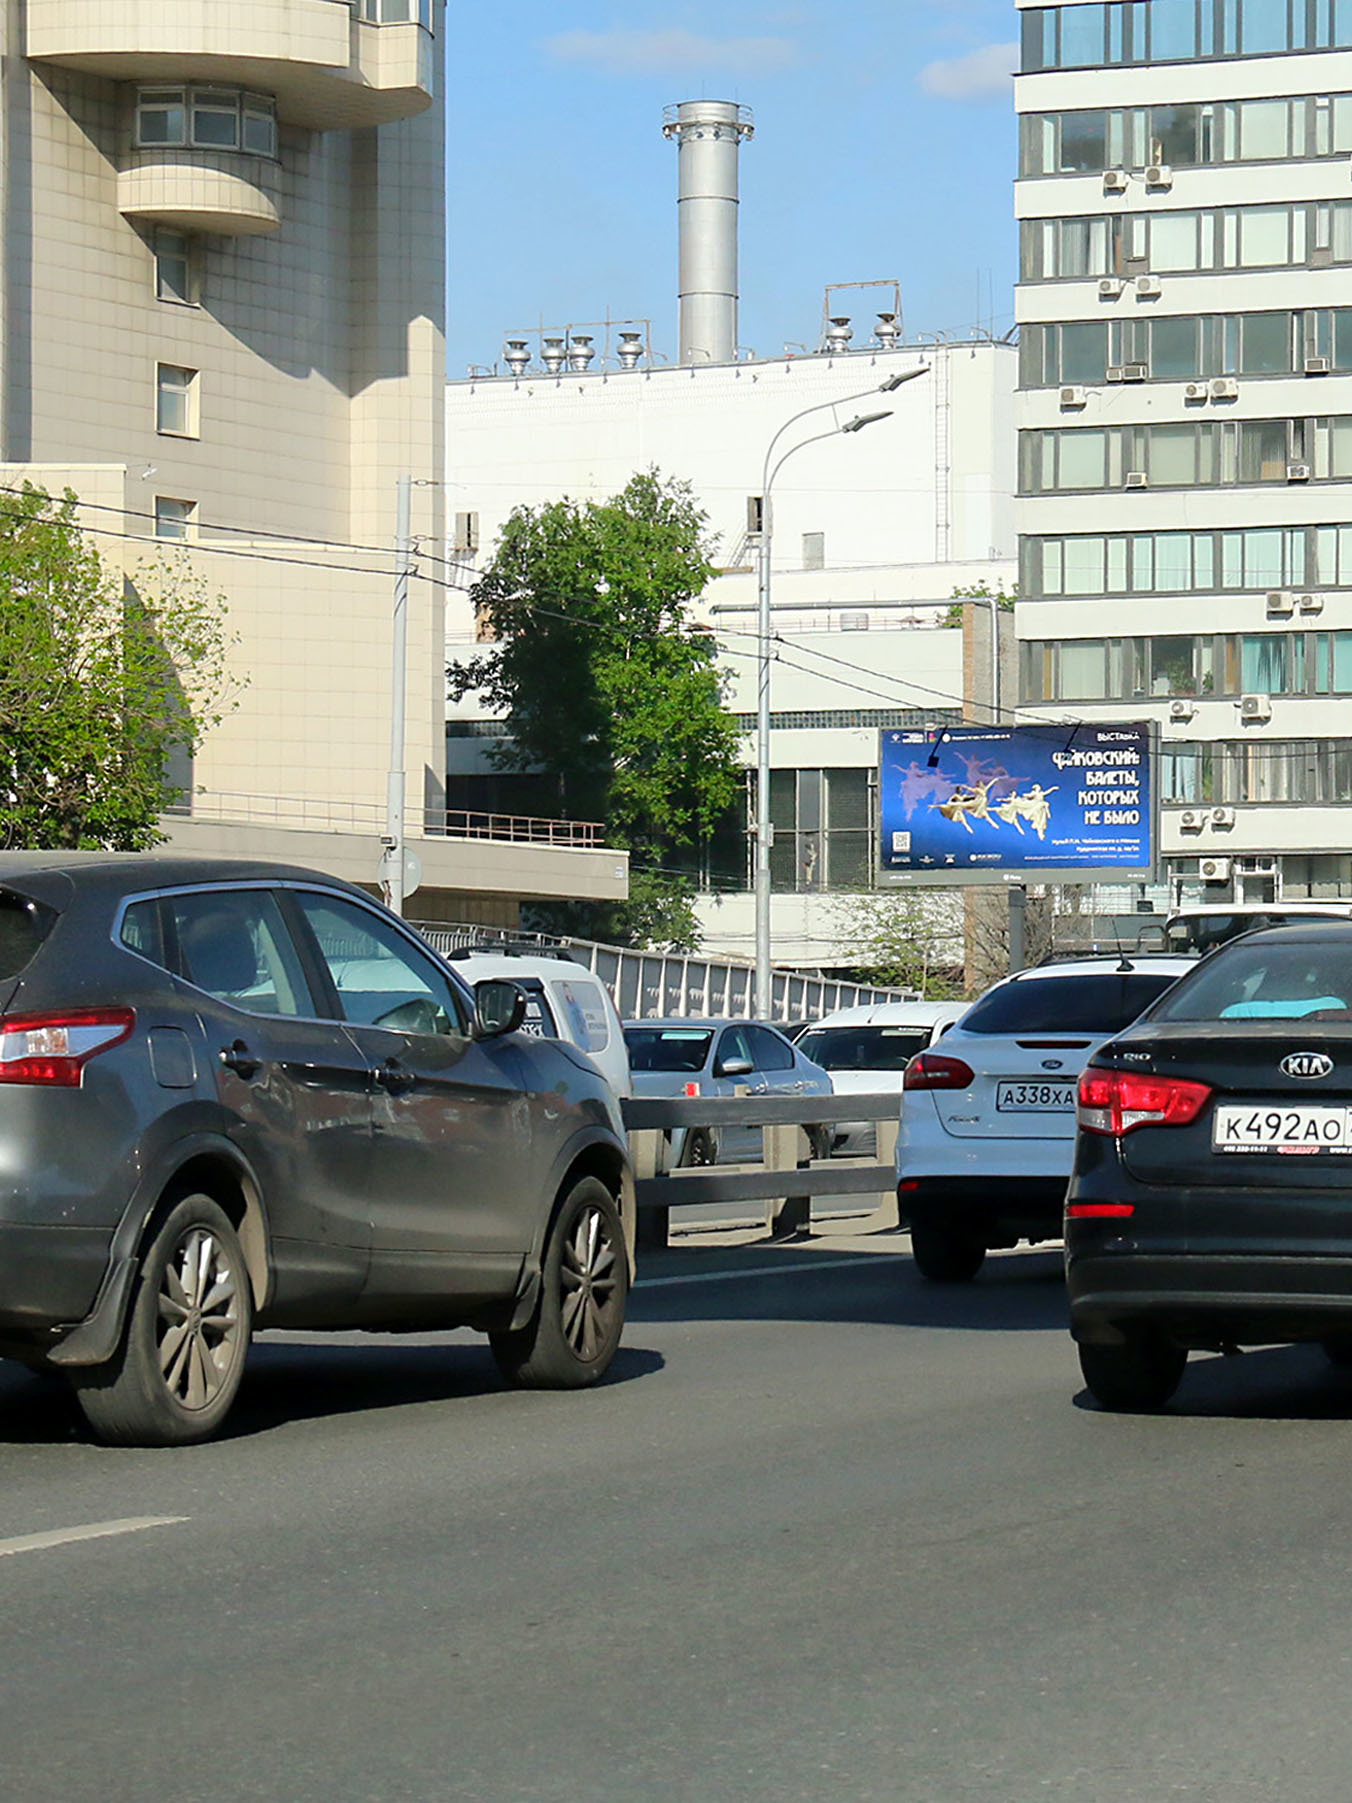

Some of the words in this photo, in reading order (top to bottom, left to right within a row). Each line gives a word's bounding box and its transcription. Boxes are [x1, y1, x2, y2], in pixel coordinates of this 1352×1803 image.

[1097, 731, 1140, 742] ВЫСТАВКА
[1078, 790, 1140, 805] КОТОРЫХ
[1084, 810, 1101, 825] НЕ
[1103, 810, 1140, 825] БЫЛО
[1123, 1052, 1151, 1061] RIO
[1288, 1057, 1326, 1074] KIA
[1003, 1086, 1074, 1105] А338ХА
[1226, 1112, 1341, 1141] К492АО
